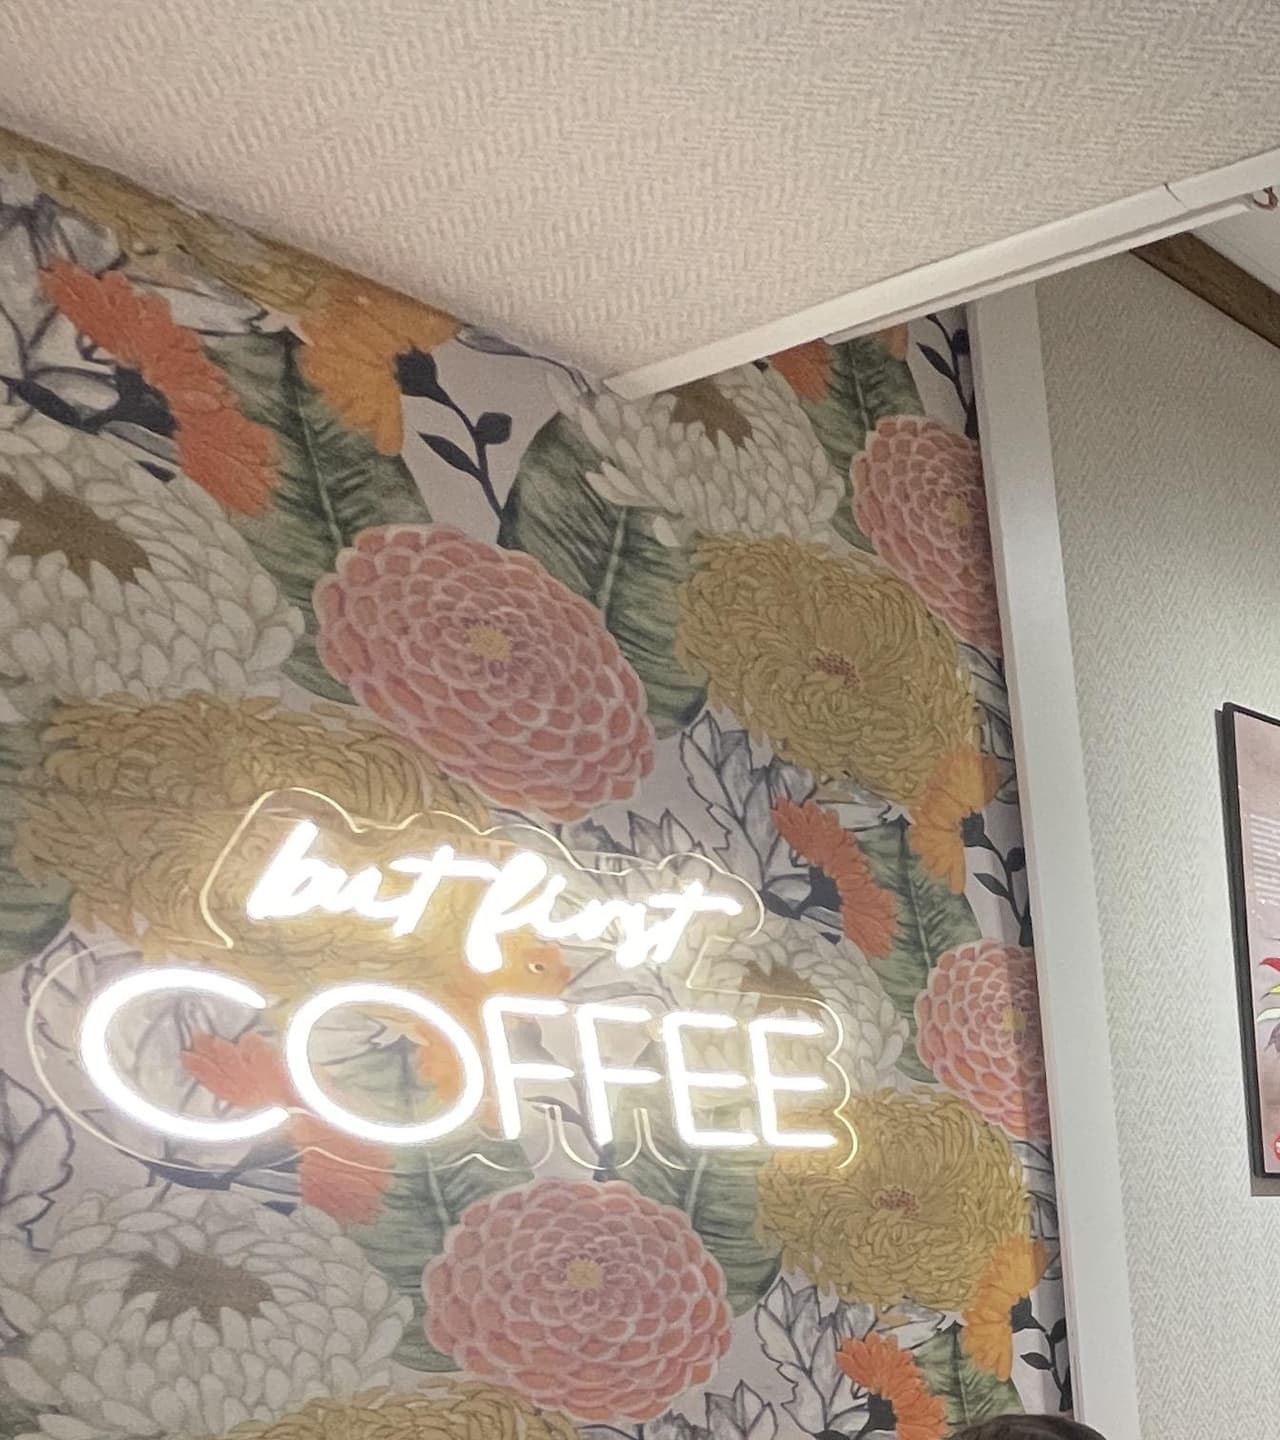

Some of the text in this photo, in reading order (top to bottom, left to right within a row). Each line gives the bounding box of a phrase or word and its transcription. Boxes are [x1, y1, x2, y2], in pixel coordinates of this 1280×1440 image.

[246, 820, 743, 973] but first
[79, 968, 837, 1145] COFFEE
